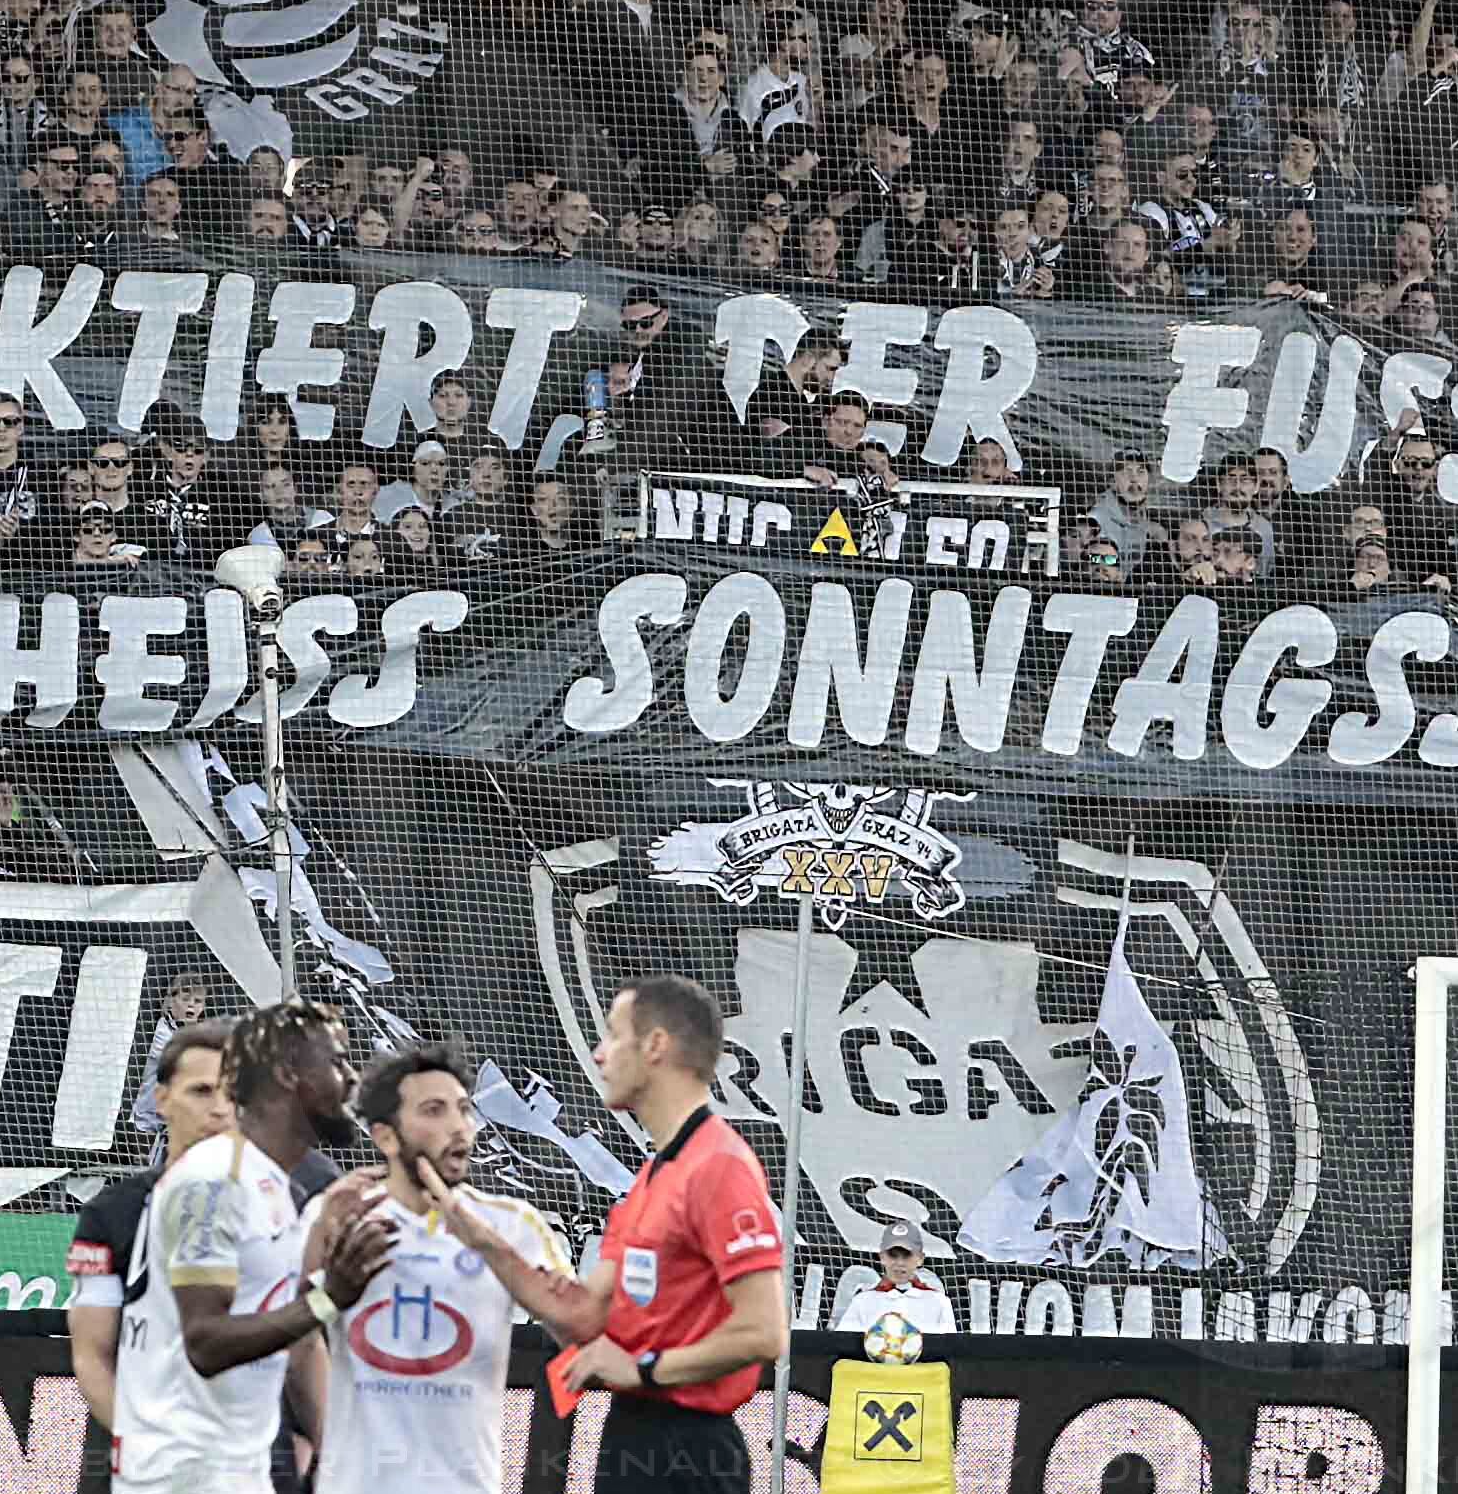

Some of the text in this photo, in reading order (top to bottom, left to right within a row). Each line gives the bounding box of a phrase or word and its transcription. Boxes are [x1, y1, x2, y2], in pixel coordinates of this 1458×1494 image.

[738, 813, 819, 849] BRIGATA
[861, 818, 912, 848] GRAZ
[781, 848, 895, 900] XXV
